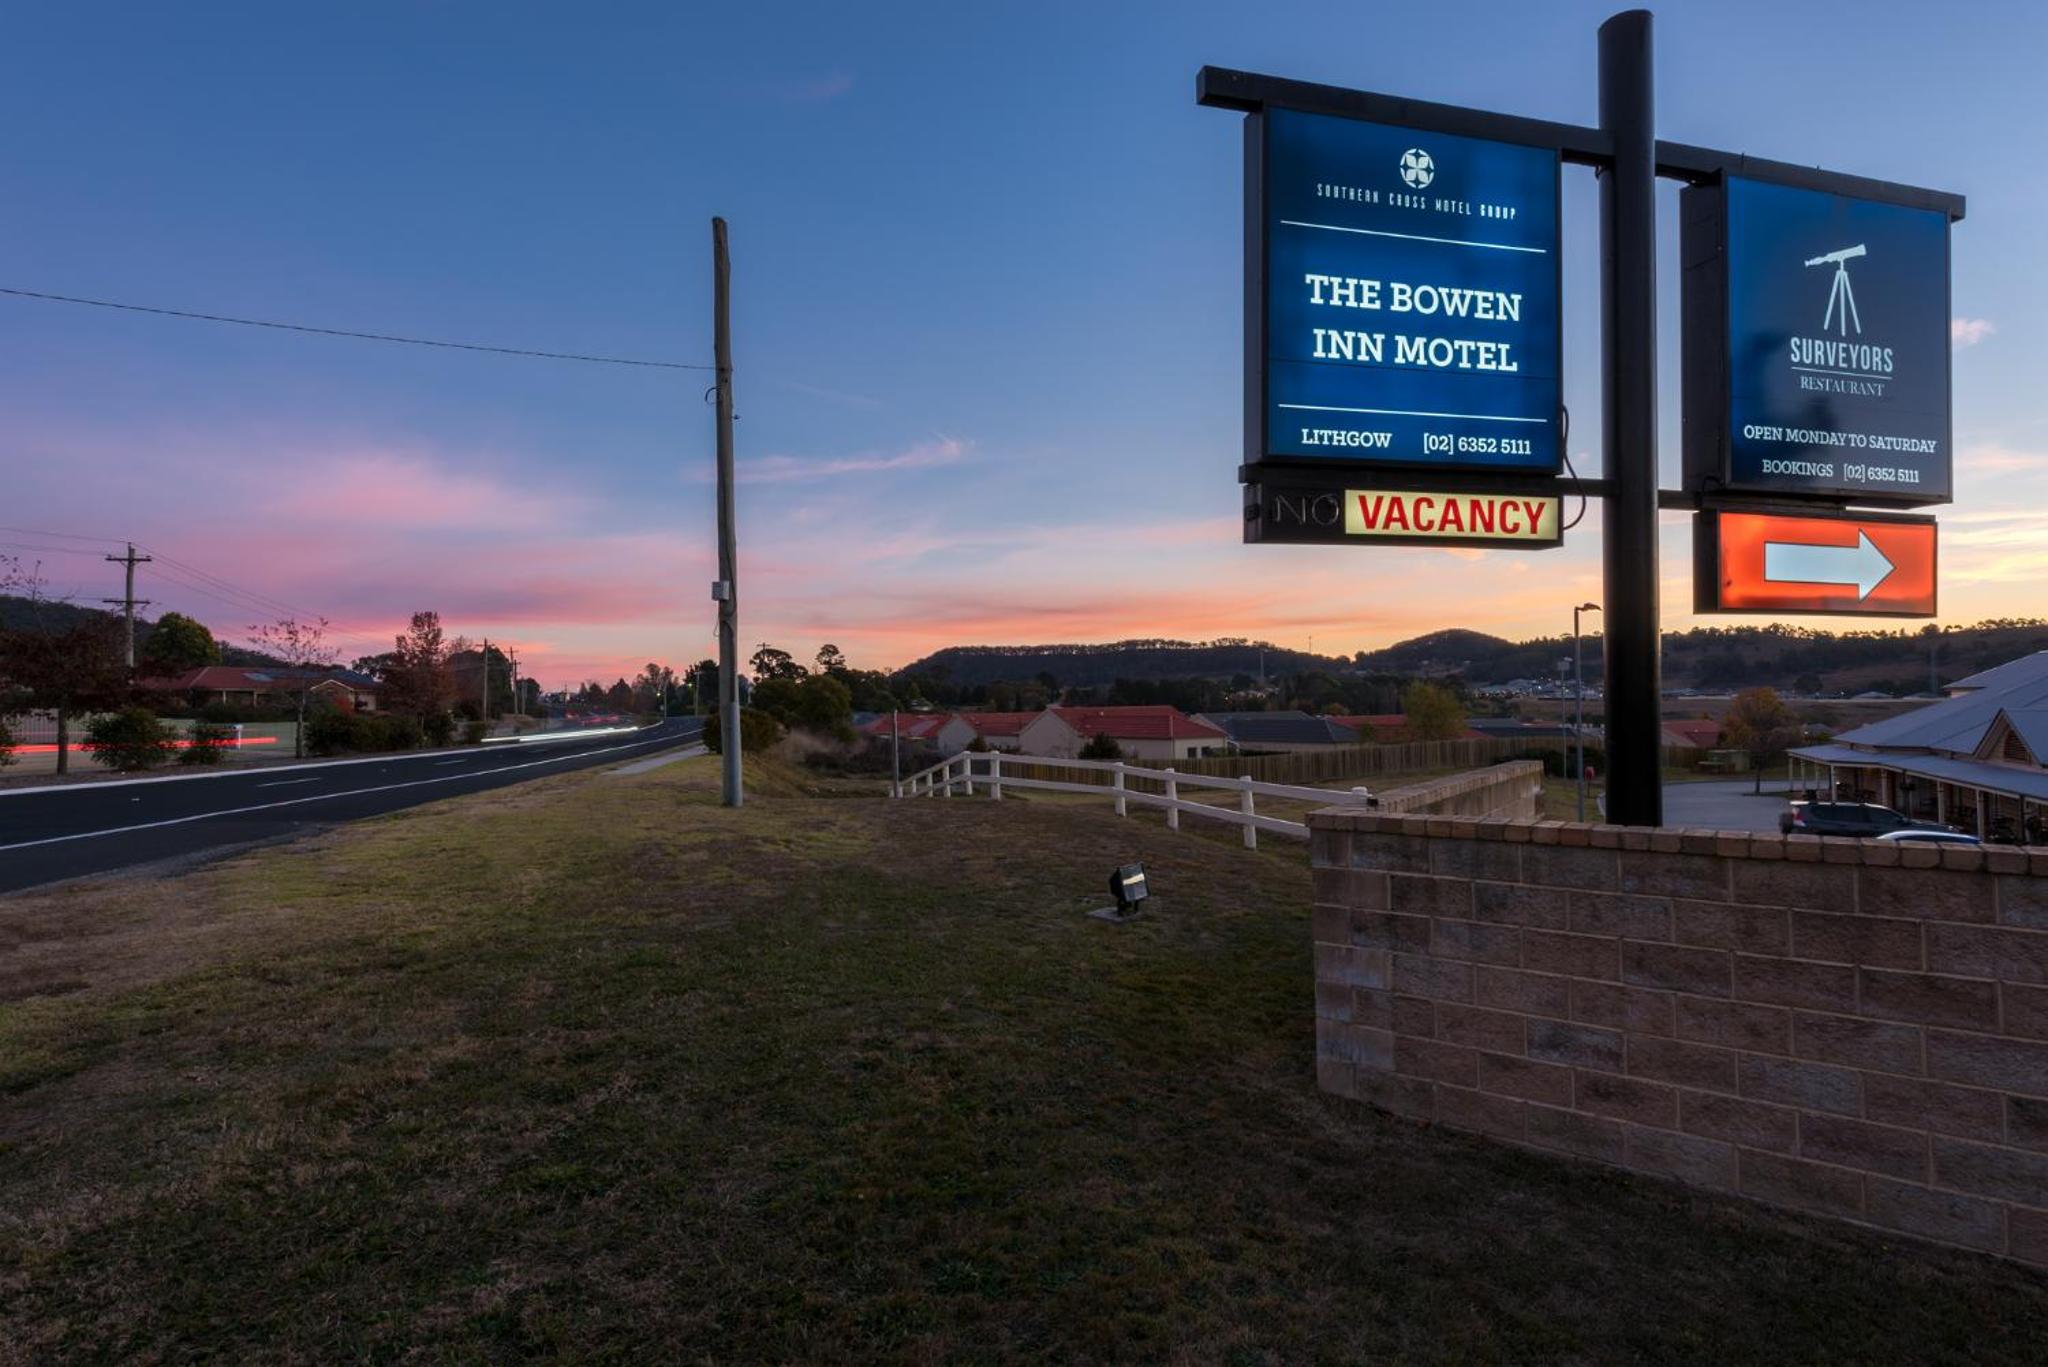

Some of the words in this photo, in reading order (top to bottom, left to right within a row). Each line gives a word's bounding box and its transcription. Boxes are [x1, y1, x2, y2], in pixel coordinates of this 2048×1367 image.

[1316, 183, 1380, 204] SOUTHERN
[1389, 192, 1426, 210] CROSS
[1435, 198, 1472, 216] MOTEL
[1480, 203, 1517, 221] GROUP
[1305, 273, 1381, 310] THE
[1390, 281, 1522, 322] BOWEN
[1313, 328, 1385, 363] INN
[1394, 334, 1518, 372] MOTEL
[1791, 337, 1893, 372] SURVEYORS
[1801, 376, 1885, 396] RESTAURANT
[1302, 428, 1392, 449] LITHGOW
[1423, 433, 1454, 455] [02]
[1458, 437, 1497, 453] 6352
[1501, 439, 1531, 455] 5111
[1744, 425, 1783, 441] OPEN
[1785, 428, 1848, 446] MONDAY
[1848, 434, 1867, 448] TO
[1869, 435, 1937, 453] SATURDAY
[1762, 459, 1834, 477] BOOKINGS
[1843, 464, 1866, 483] [02]
[1867, 467, 1896, 482] 6352
[1897, 469, 1920, 483] 5111
[1275, 494, 1339, 526] NO
[1358, 494, 1546, 534] VACANCY
